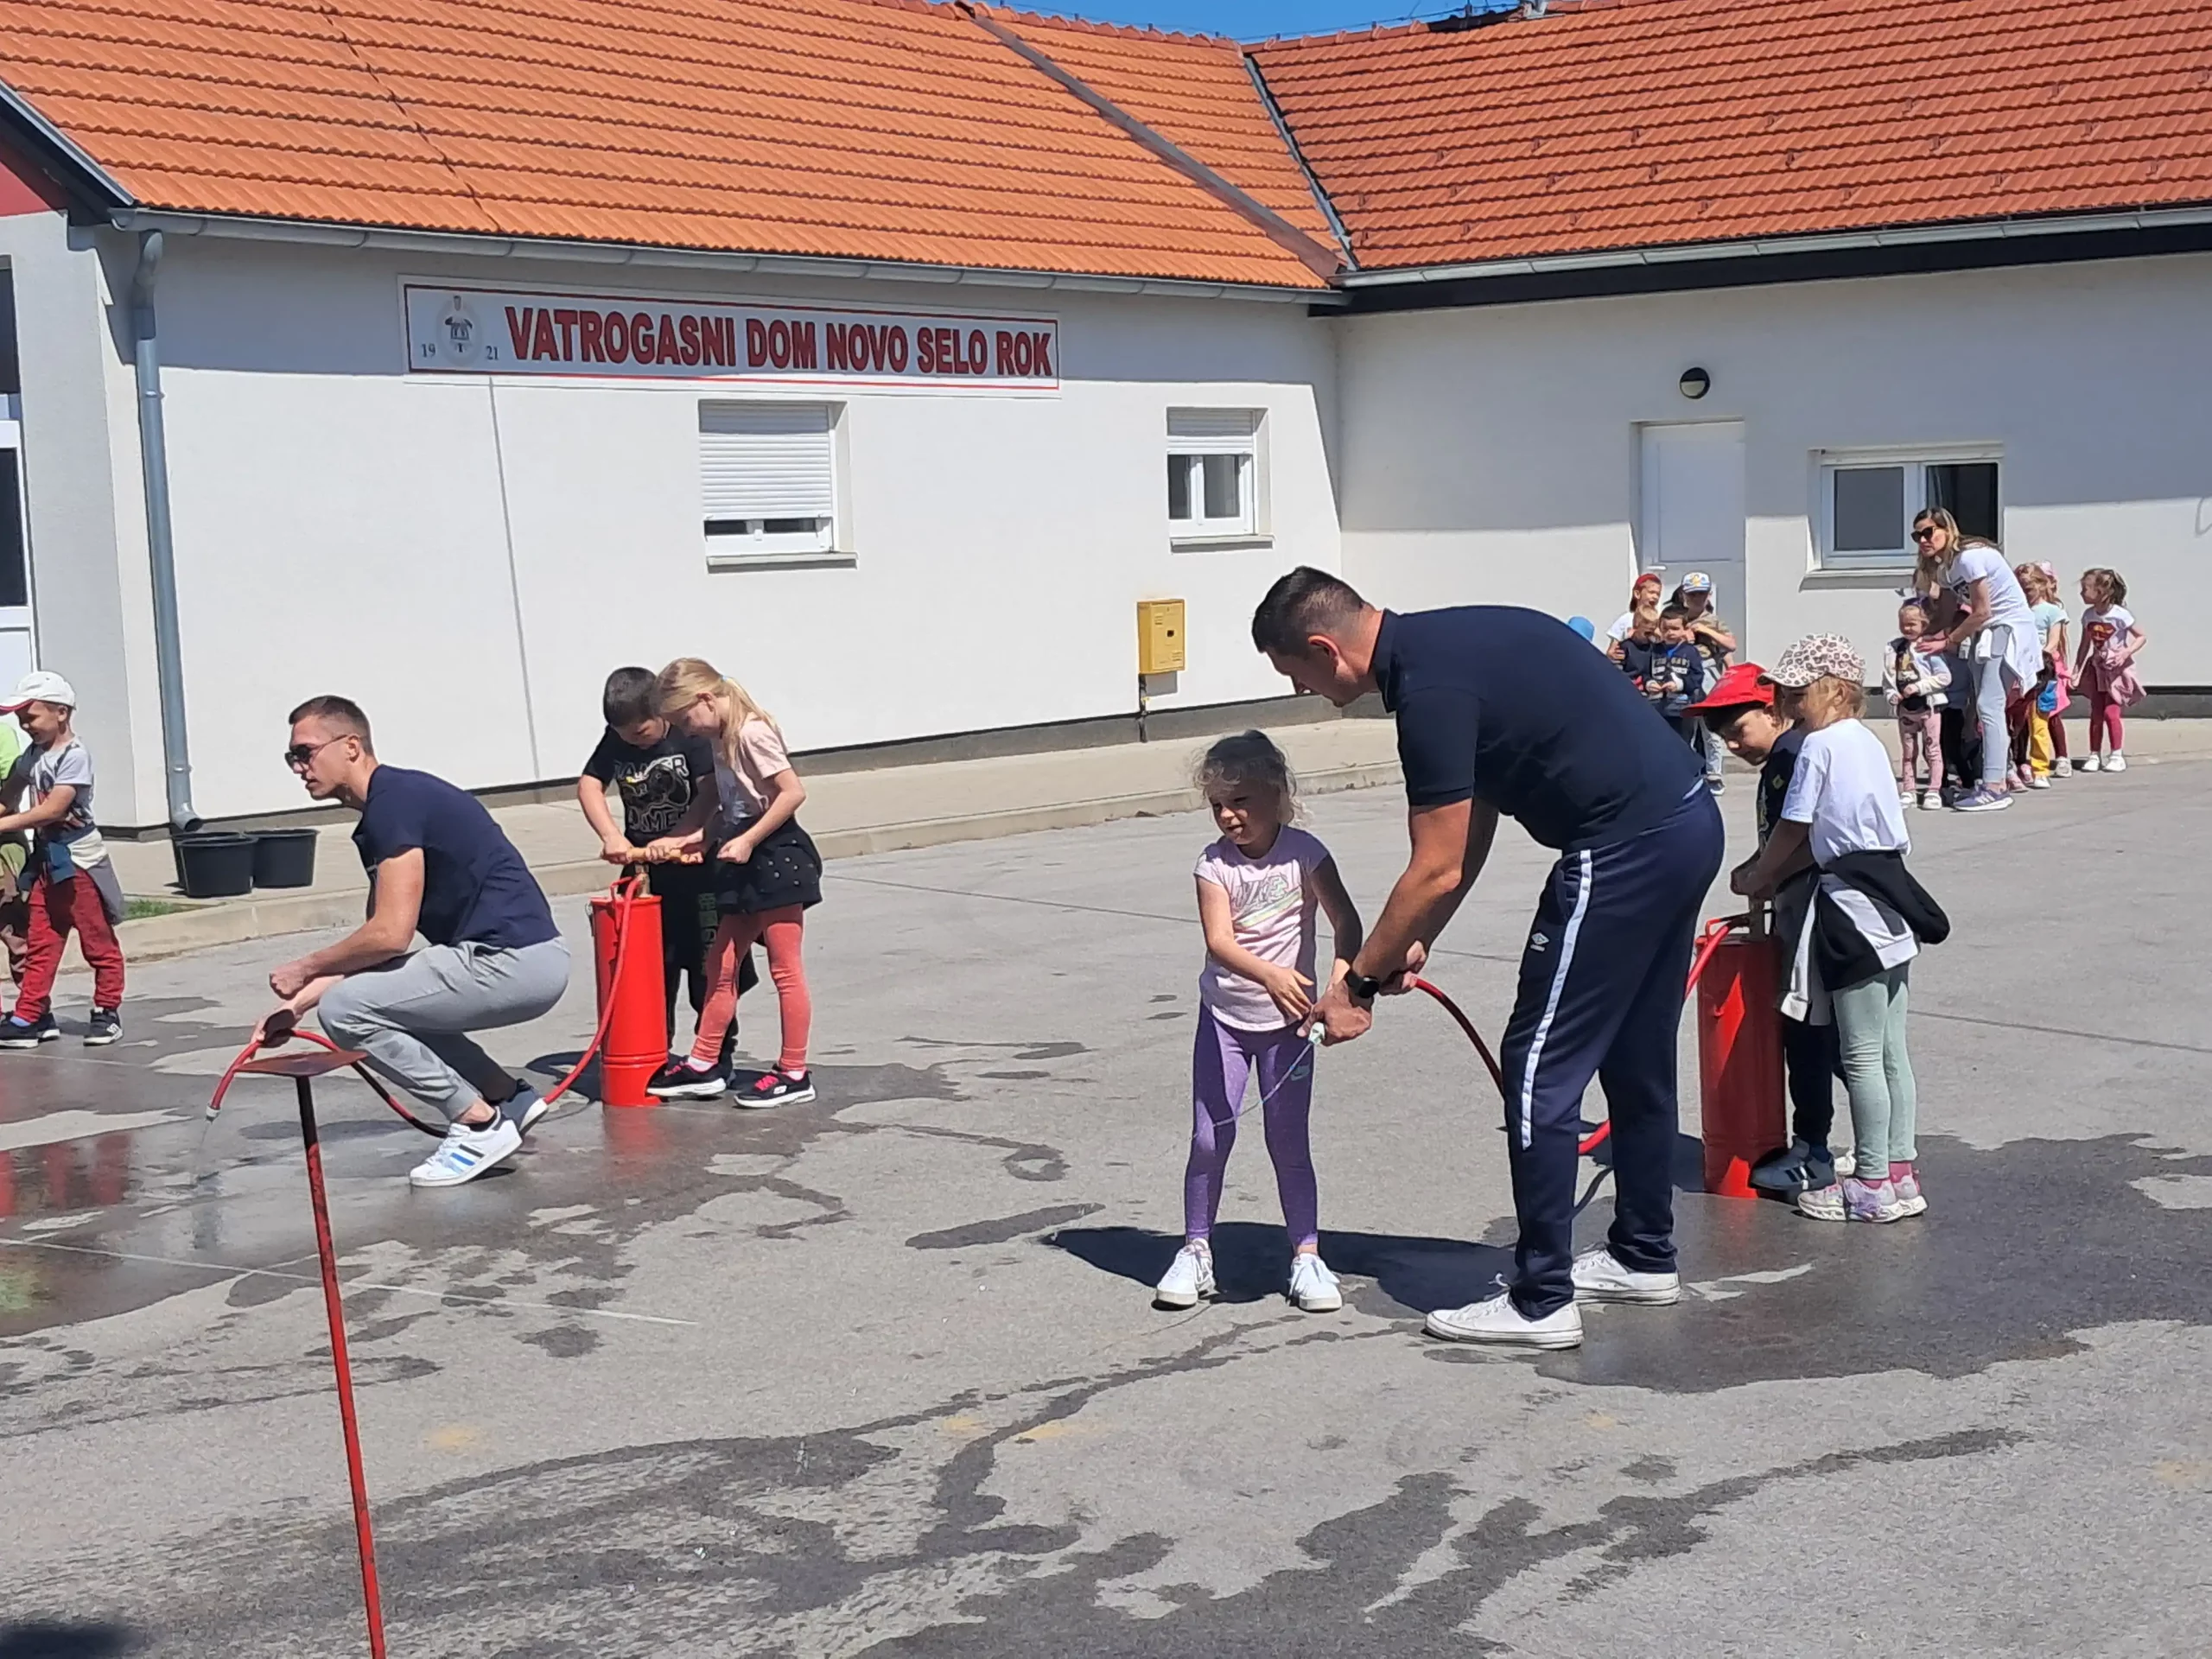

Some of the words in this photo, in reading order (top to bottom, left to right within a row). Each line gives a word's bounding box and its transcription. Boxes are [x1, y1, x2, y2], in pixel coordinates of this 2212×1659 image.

[422, 343, 435, 357] 19
[486, 345, 499, 360] 21
[505, 306, 736, 367] VATROGASNI
[746, 318, 817, 370] DOM
[826, 322, 908, 372] NOVO
[917, 327, 988, 375] SELO
[995, 331, 1052, 377] ROK
